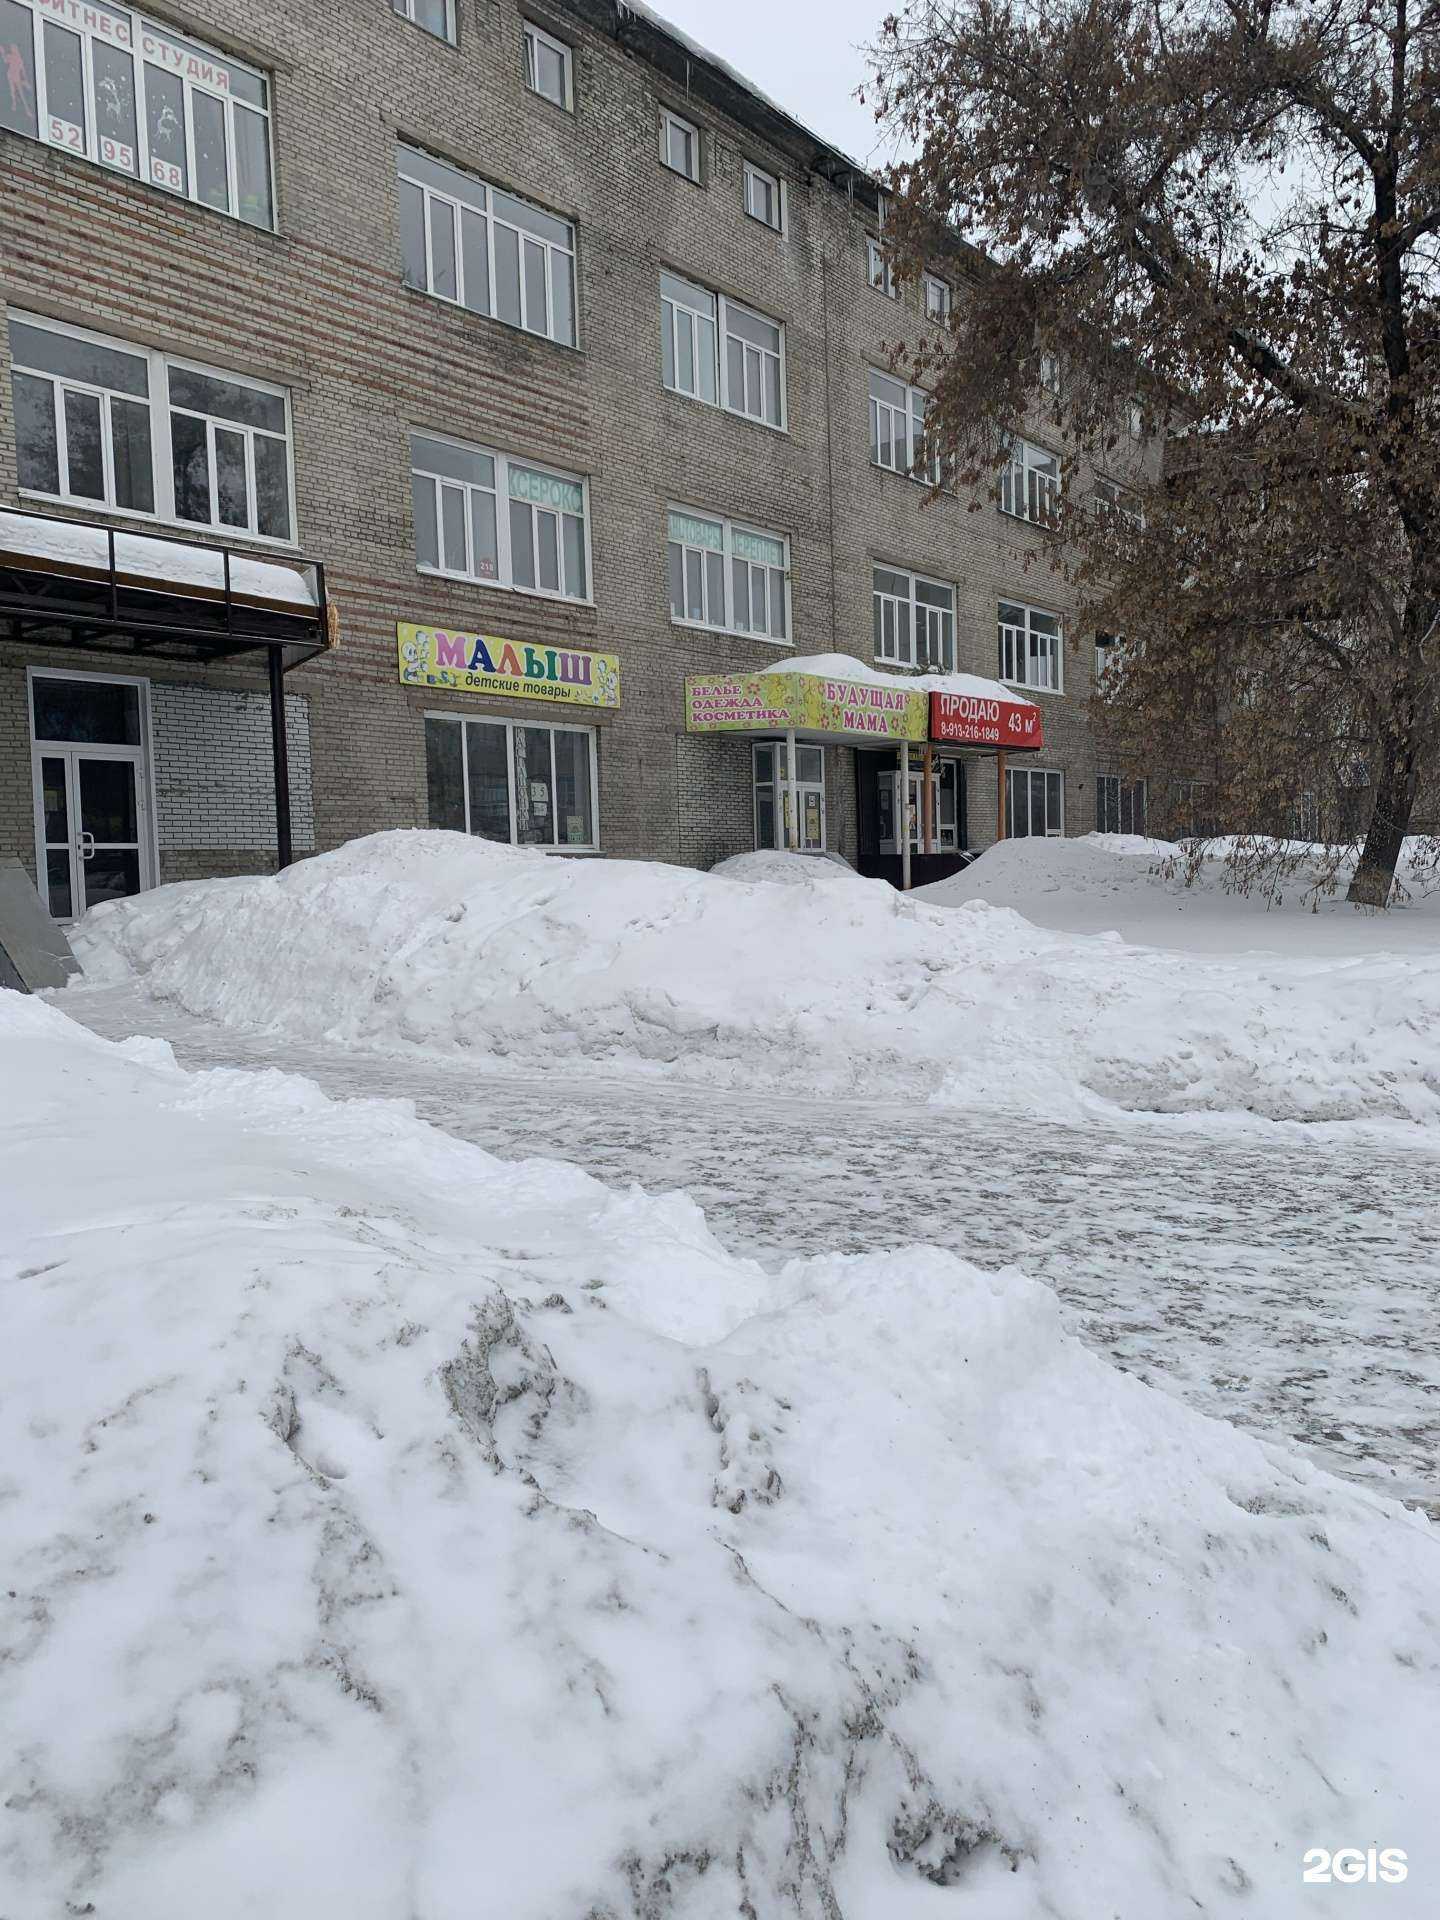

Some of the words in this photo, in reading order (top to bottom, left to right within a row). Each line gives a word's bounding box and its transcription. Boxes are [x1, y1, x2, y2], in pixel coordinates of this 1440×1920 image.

[38, 0, 128, 42] ИТНЕС
[142, 38, 228, 89] СТУДИЯ
[51, 122, 82, 149] 52
[104, 140, 131, 166] 95
[152, 161, 180, 186] 68
[435, 632, 592, 685] МАЛЫШ
[465, 672, 520, 692] детские
[522, 682, 571, 699] товары
[691, 685, 742, 697] БЕЛЬЕ
[825, 683, 904, 710] БУДУЩАЯ
[691, 697, 763, 709] ОДЕЖДА
[691, 709, 790, 722] КОСМЕТИКА
[940, 694, 1000, 723] ПРОДАЮ
[843, 710, 888, 733] МАМА
[940, 722, 999, 741] 8-913-216-1849
[1008, 713, 1022, 732] 43
